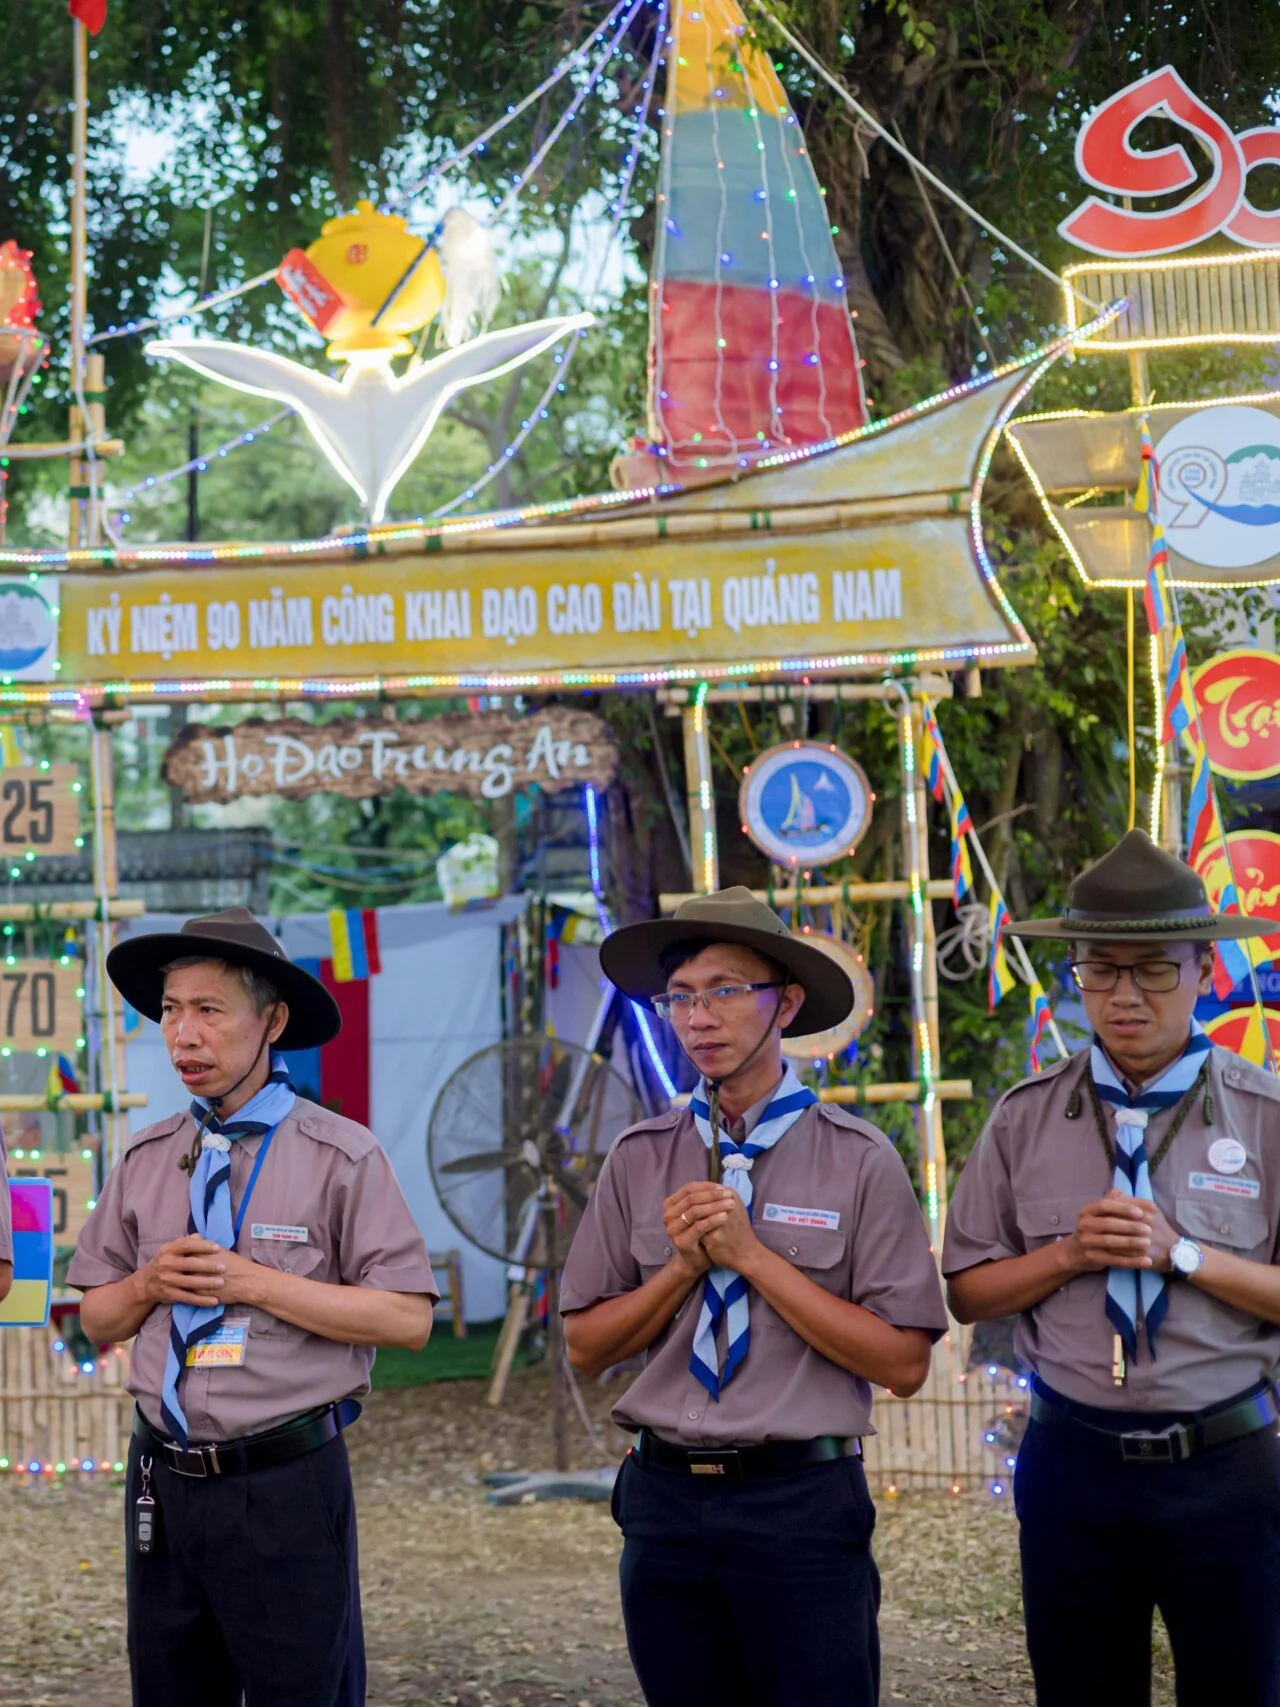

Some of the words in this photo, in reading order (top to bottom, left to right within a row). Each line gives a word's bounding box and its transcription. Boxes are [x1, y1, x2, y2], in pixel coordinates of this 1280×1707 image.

[130, 592, 198, 661] NIỆM
[206, 601, 240, 650] 90
[248, 587, 314, 648] NĂM
[321, 583, 395, 645] CÔNG
[405, 588, 471, 641] KHAI
[482, 585, 538, 646] ĐẠO
[546, 583, 603, 634] CAO
[612, 571, 661, 632] ĐÀI
[668, 578, 711, 639] TẠI
[722, 558, 819, 634] QUẢNG
[832, 567, 903, 622] NAM
[359, 731, 516, 799] Trung
[525, 725, 591, 779] An
